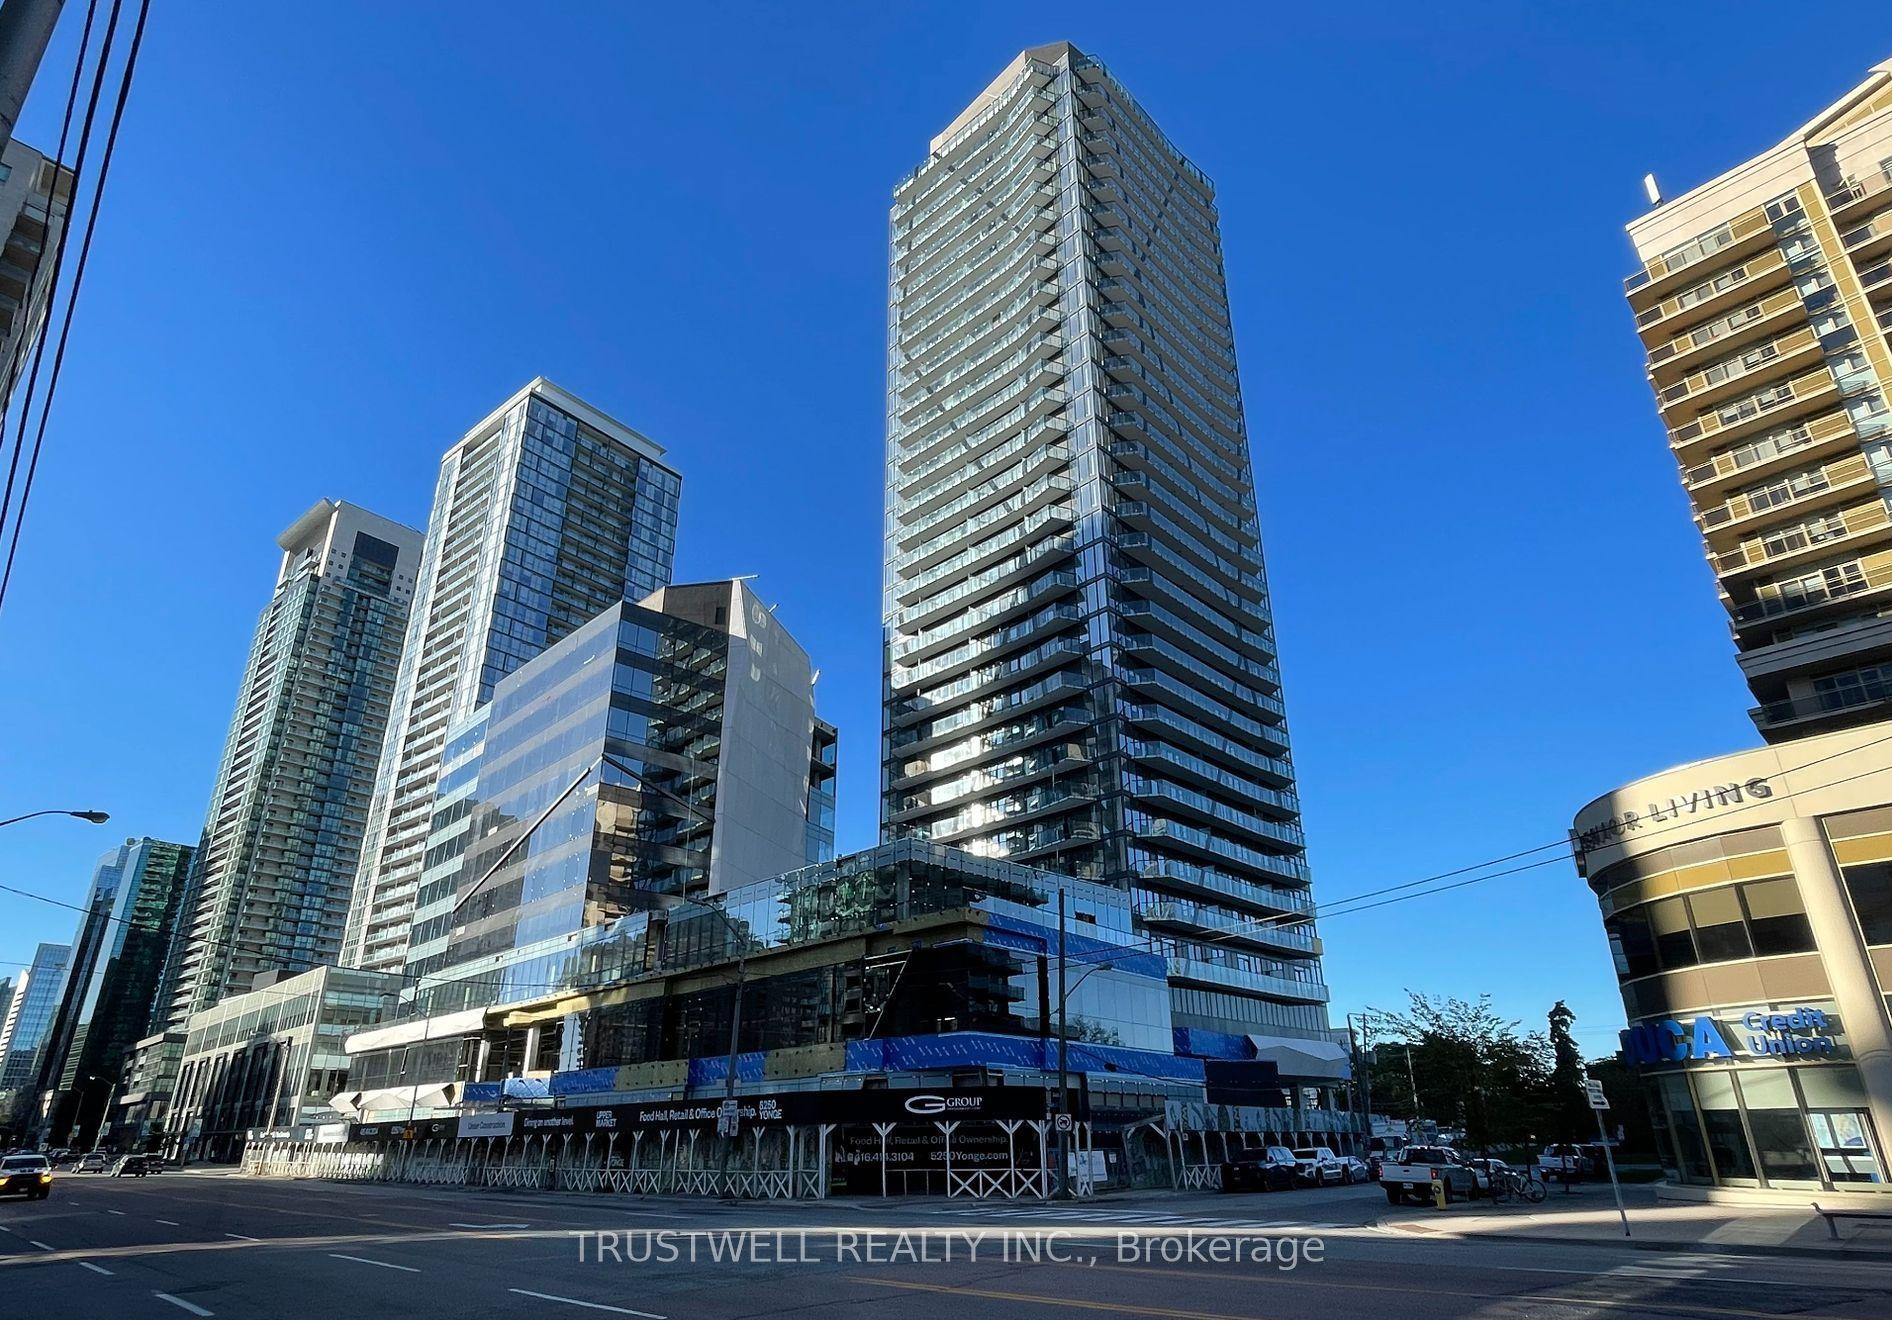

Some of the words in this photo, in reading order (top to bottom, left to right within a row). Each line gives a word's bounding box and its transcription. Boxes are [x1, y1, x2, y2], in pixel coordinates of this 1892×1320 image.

[1648, 777, 1774, 823] LIVING
[1741, 1006, 1828, 1032] Credit
[1747, 1032, 1833, 1056] Union
[946, 1097, 983, 1107] GROUP
[596, 1110, 613, 1119] UPPER
[639, 1111, 655, 1122] Food
[669, 1109, 688, 1120] Retail
[689, 1109, 695, 1120] &
[695, 1107, 716, 1119] Office
[716, 1105, 757, 1120] Orship.
[759, 1109, 783, 1120] YONGE
[595, 1118, 617, 1128] MARKET
[850, 1136, 872, 1145] Food
[922, 1135, 930, 1145] &
